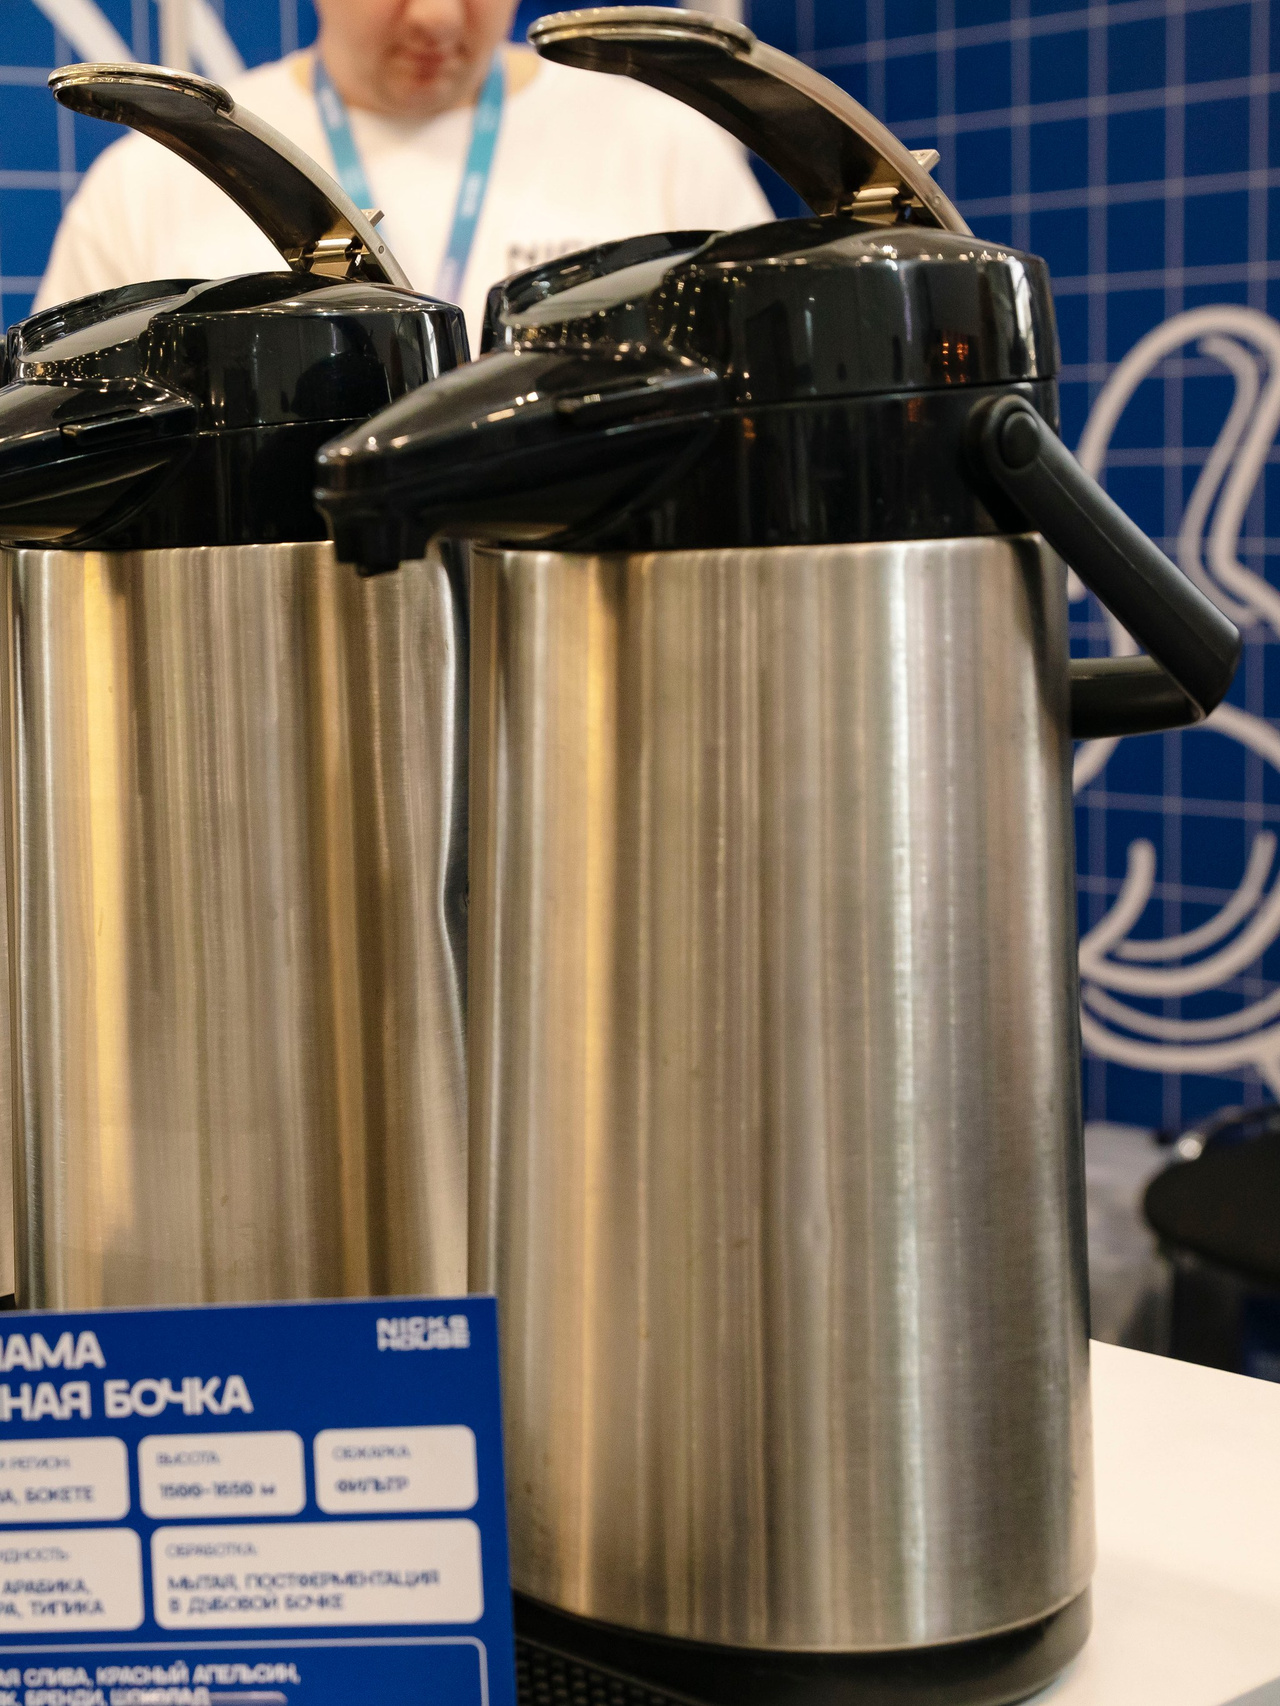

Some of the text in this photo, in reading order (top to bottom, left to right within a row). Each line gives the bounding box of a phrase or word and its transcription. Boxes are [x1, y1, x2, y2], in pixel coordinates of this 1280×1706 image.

[376, 1314, 468, 1338] NICKS
[377, 1330, 470, 1351] HOUSE
[103, 1375, 254, 1419] БОЧКА
[25, 1484, 96, 1505] БОКЕТЕ
[334, 1475, 410, 1494] ФИЛЬТР
[1, 1578, 92, 1596] АРАБИКА,
[167, 1568, 440, 1592] МЫТАЯ, ПОСТФЕРМЕНТАЦИЯ
[31, 1598, 105, 1617] ТИПИКА
[169, 1593, 345, 1616] В ДУБОВОЙ БОЧКЕ
[23, 1667, 94, 1690] СЛИВА,
[96, 1660, 190, 1687] КРАСНЫЙ
[192, 1661, 301, 1686] АПЕЛЬСИН,
